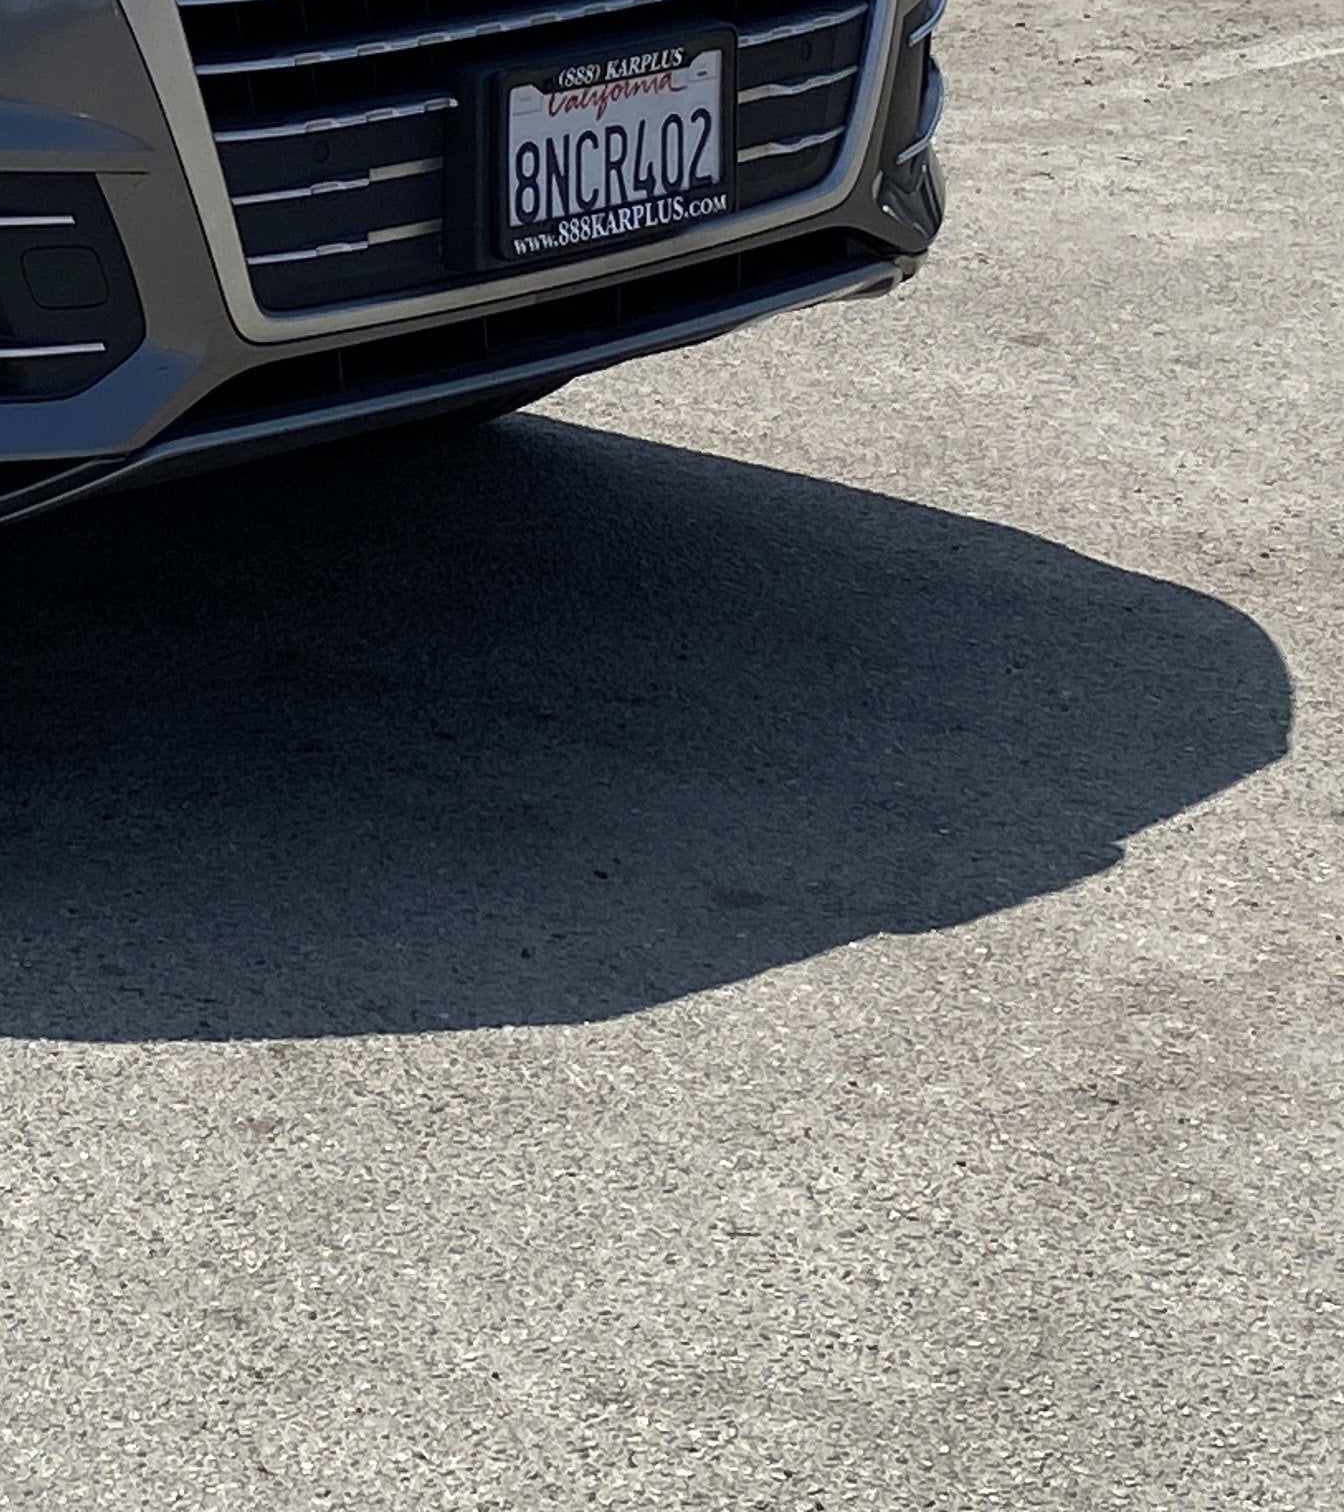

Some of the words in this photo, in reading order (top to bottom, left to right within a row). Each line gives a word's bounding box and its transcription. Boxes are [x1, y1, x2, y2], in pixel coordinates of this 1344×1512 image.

[558, 63, 602, 88] (888)
[604, 46, 686, 81] KARPLUS
[547, 71, 688, 121] California
[514, 107, 713, 225] 8NCR402
